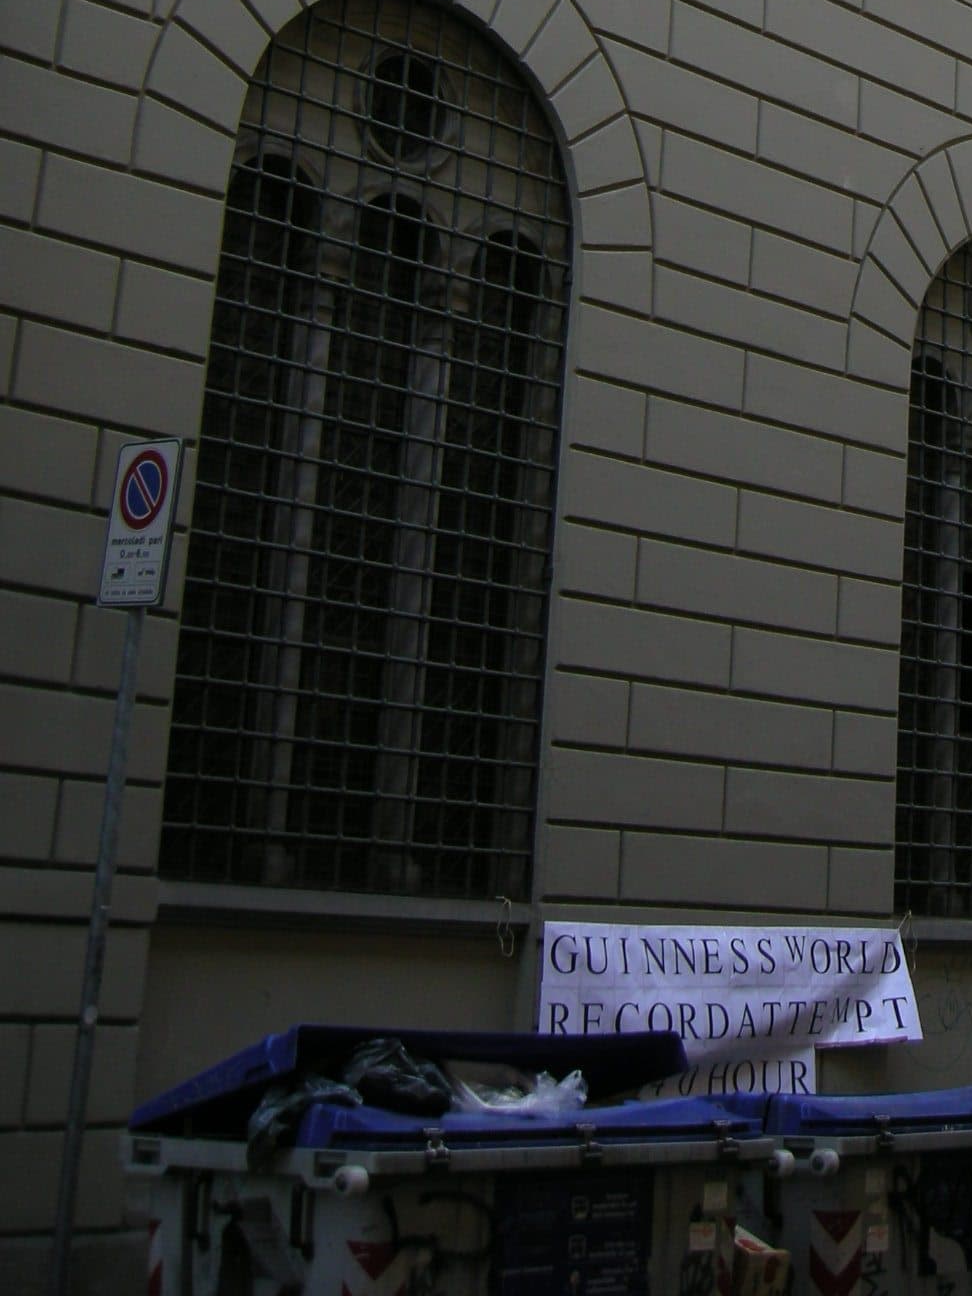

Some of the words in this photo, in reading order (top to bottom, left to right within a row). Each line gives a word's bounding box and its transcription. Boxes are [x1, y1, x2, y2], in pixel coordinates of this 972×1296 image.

[550, 934, 776, 975] GUINNESS
[785, 935, 901, 974] WORLD
[548, 1002, 729, 1040] RECORD
[736, 996, 908, 1039] ATTEMPT
[708, 1059, 811, 1096] HOUR
